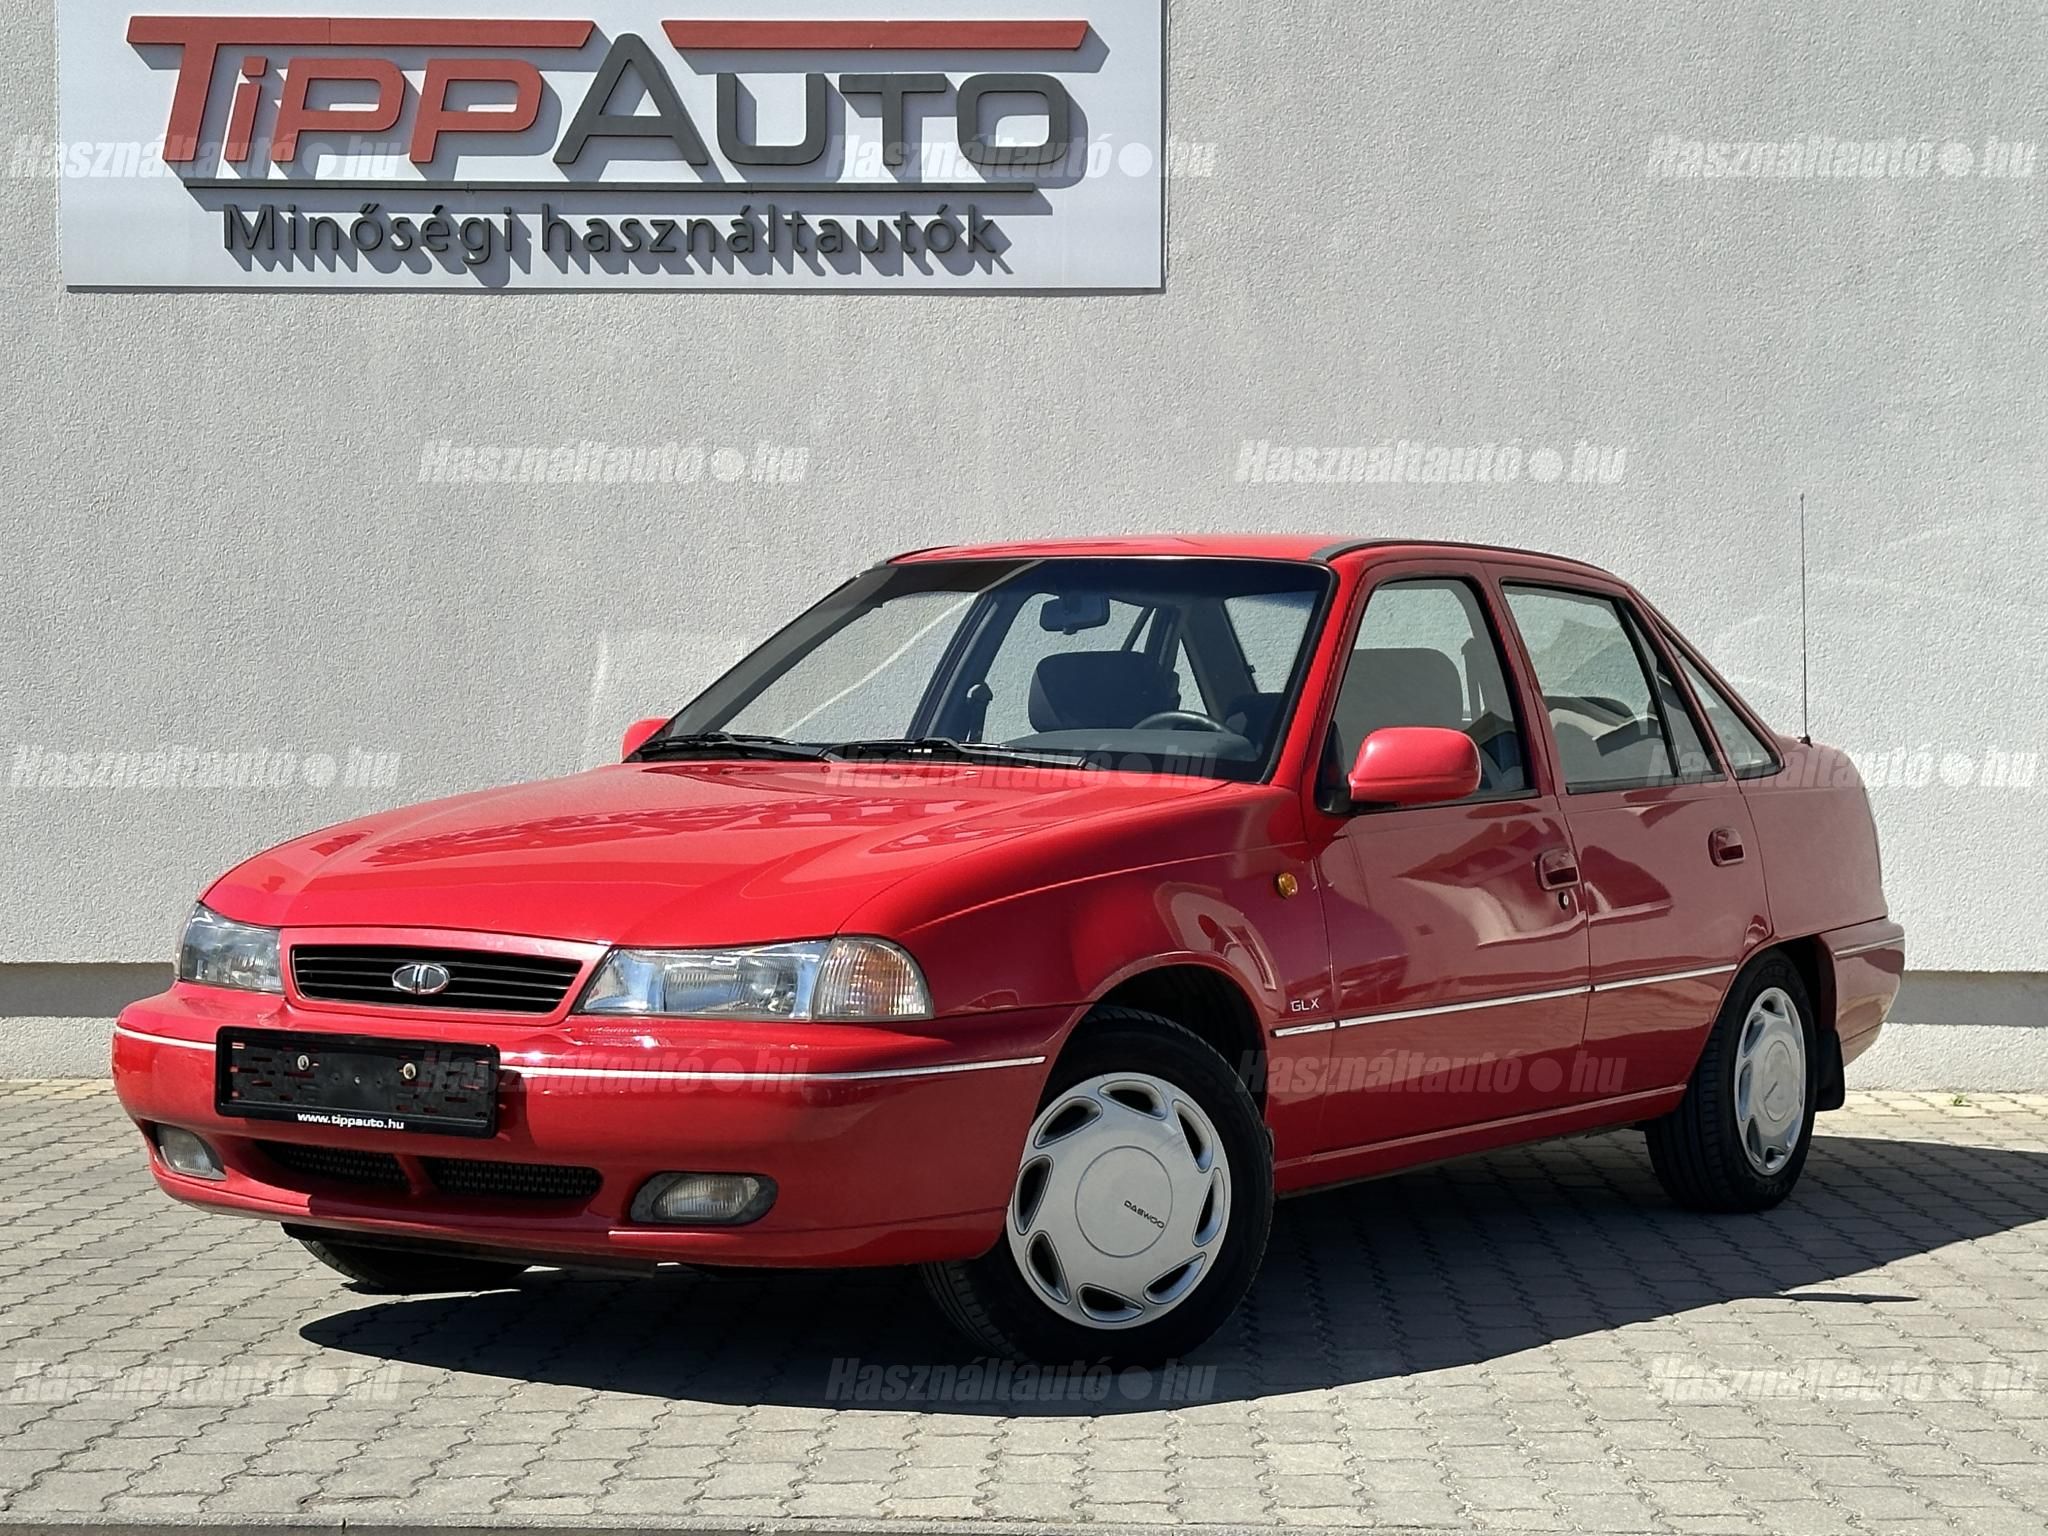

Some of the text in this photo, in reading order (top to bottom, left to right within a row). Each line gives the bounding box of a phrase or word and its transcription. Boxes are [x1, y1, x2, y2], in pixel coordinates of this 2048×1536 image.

[222, 202, 997, 265] Minőségi használtautók
[1290, 997, 1320, 1012] GLX
[296, 1111, 405, 1131] www.tippauto.hu
[1123, 1199, 1165, 1229] DAEWOO
